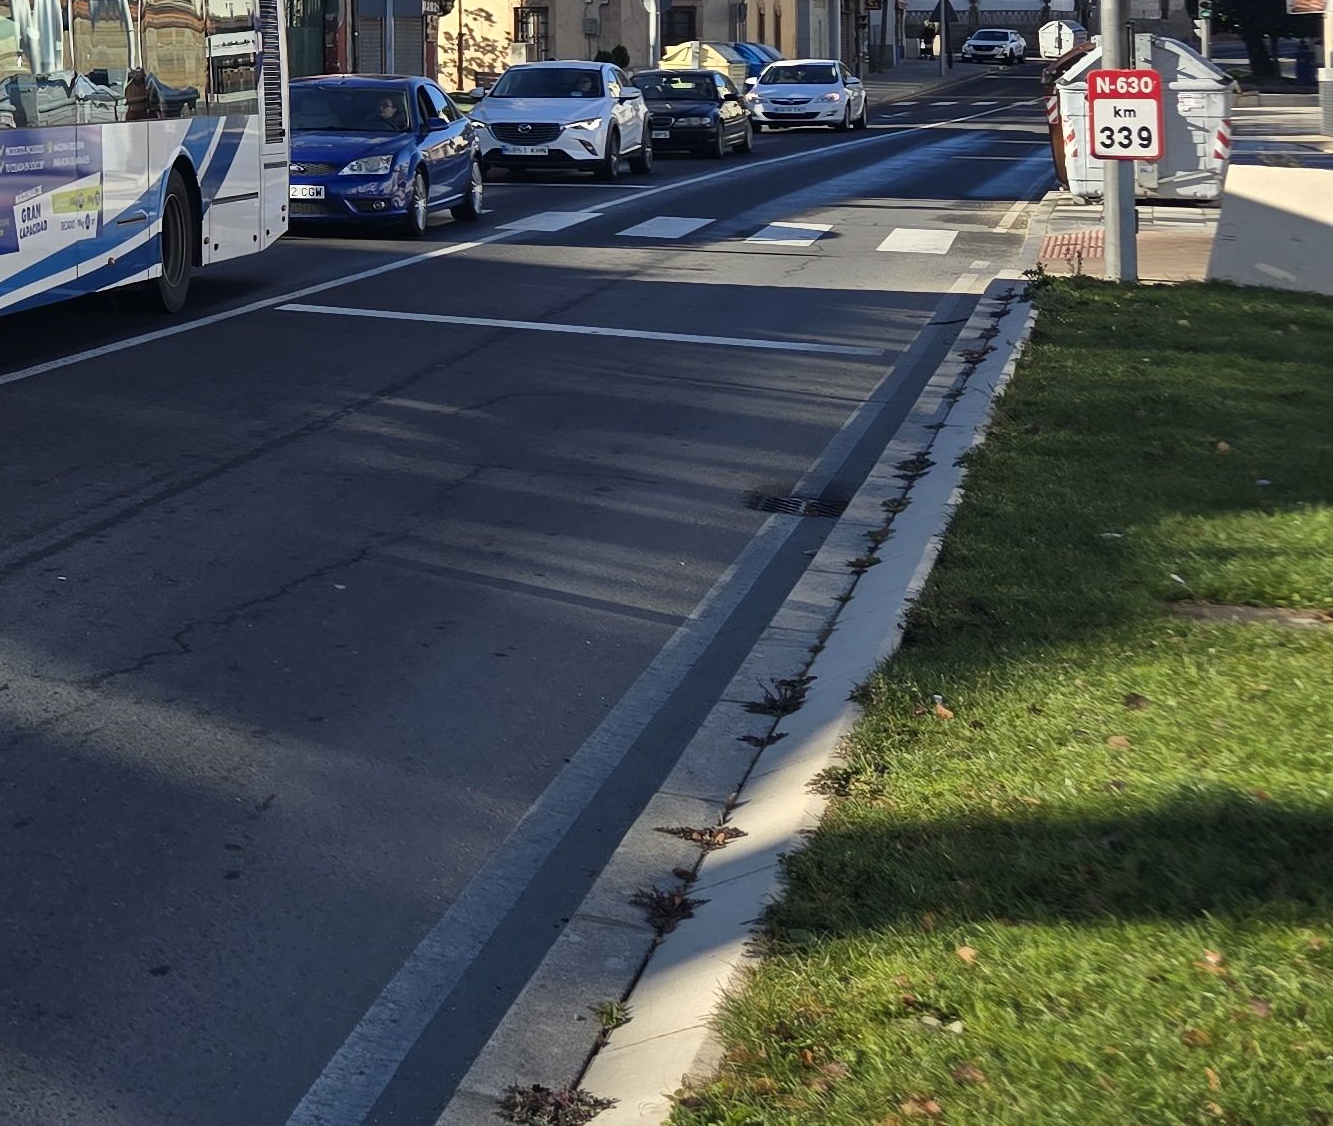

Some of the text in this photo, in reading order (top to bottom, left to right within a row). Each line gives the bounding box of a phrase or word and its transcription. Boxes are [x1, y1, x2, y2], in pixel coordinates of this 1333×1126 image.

[1096, 76, 1153, 94] N-630
[1113, 105, 1137, 118] km
[1099, 126, 1153, 149] 339
[301, 187, 322, 197] CGW
[21, 203, 41, 224] GRAN
[19, 219, 48, 240] CAPACIDAD
